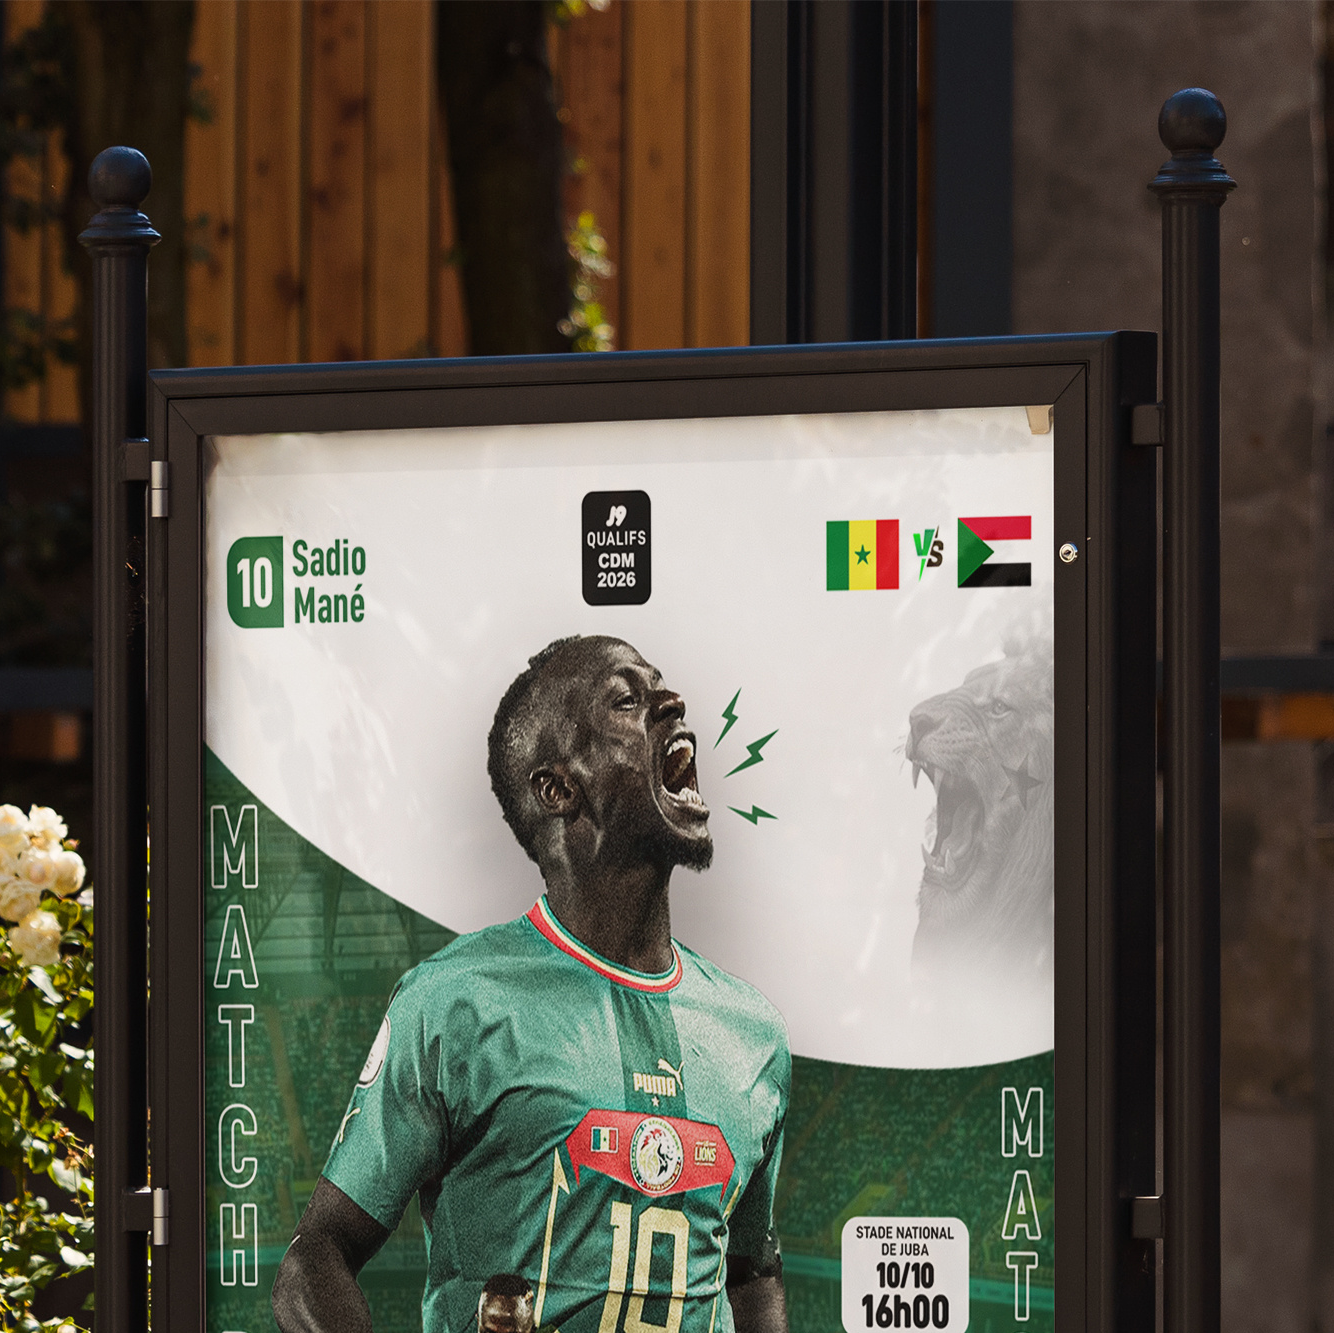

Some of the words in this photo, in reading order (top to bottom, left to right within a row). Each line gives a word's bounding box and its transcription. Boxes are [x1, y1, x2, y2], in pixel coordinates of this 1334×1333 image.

[587, 530, 646, 549] QUALIFS
[292, 538, 366, 577] Sadio
[598, 553, 635, 568] CDM
[236, 556, 273, 608] 10
[597, 571, 636, 588] 2026
[294, 583, 365, 624] Mané
[210, 805, 259, 1286] MATCH
[633, 1072, 677, 1097] PUMA
[856, 1226, 893, 1239] STADE
[896, 1226, 954, 1240] NATIONAL
[881, 1243, 897, 1256] DE
[899, 1243, 929, 1256] JUBA
[876, 1261, 935, 1289] 10/10
[862, 1294, 950, 1329] 16h00
